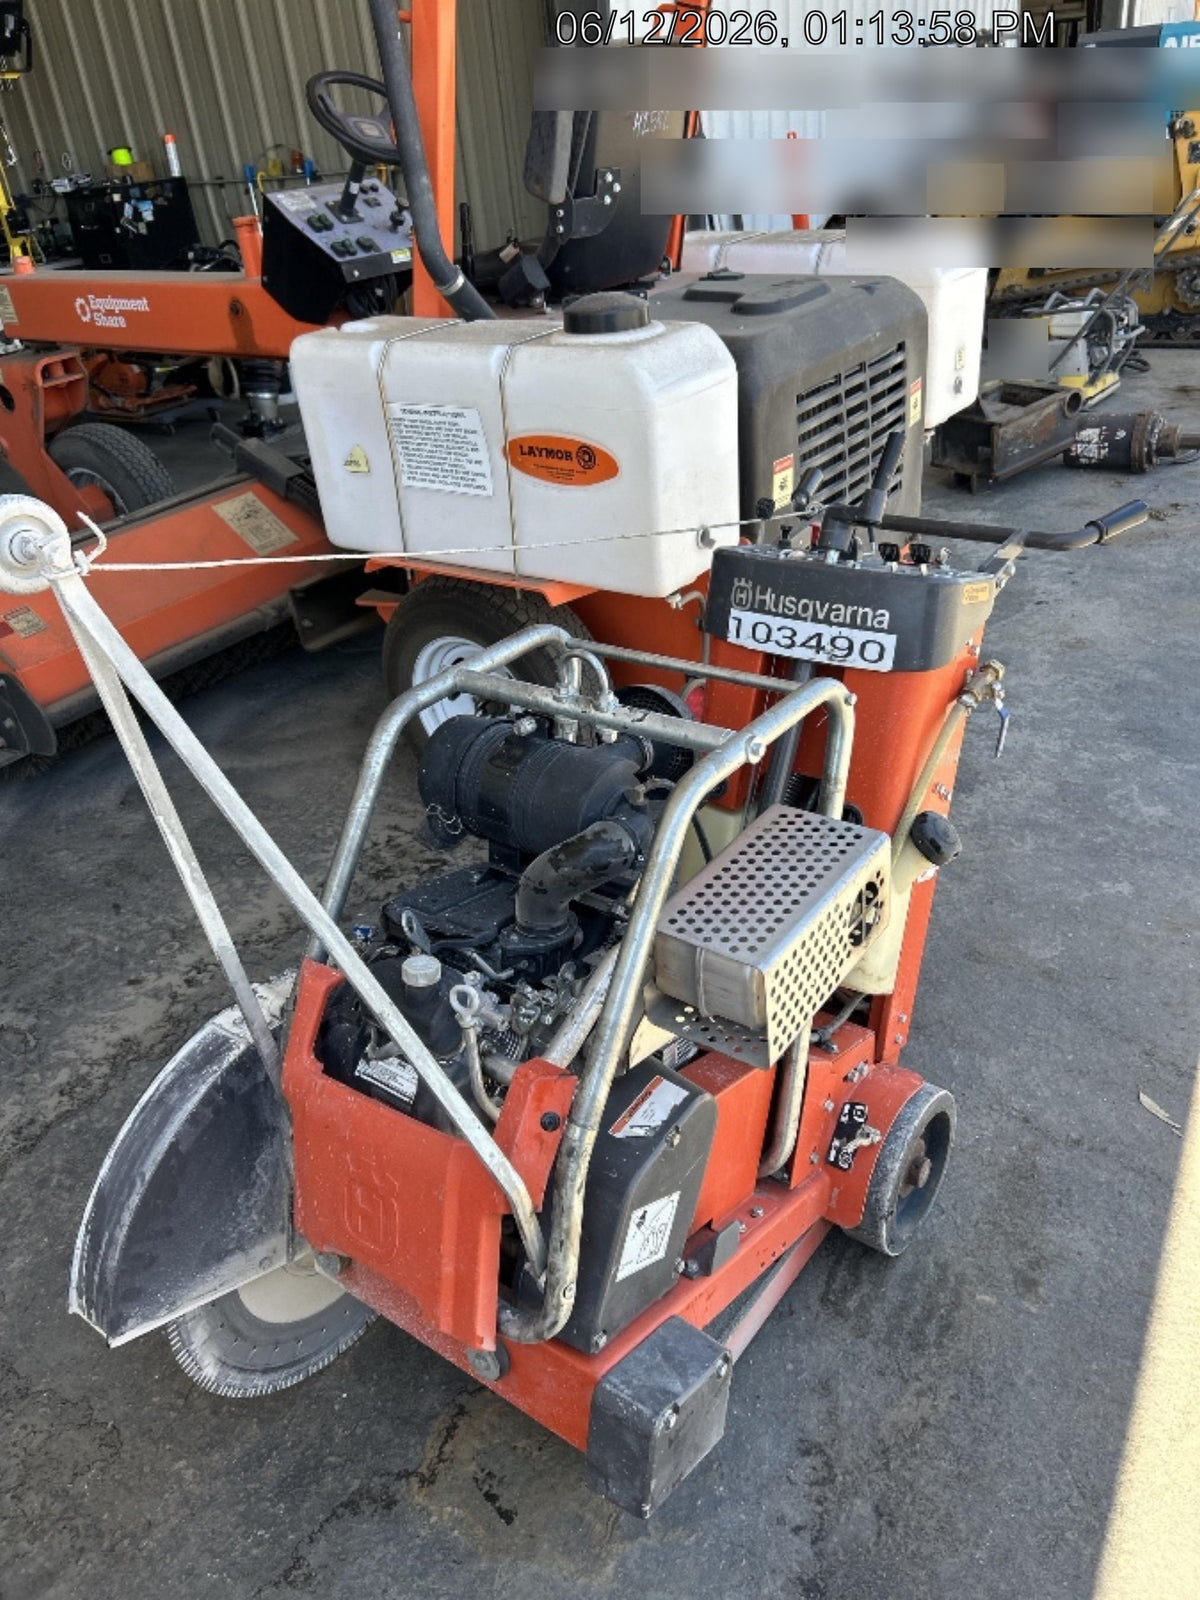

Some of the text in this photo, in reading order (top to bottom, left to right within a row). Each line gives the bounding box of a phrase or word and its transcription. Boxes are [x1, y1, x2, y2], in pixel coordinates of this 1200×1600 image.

[88, 295, 150, 313] Equipment
[94, 312, 126, 328] Share
[519, 445, 573, 461] LAYMOR
[754, 585, 890, 629] Husqvarna
[732, 616, 886, 664] 103490
